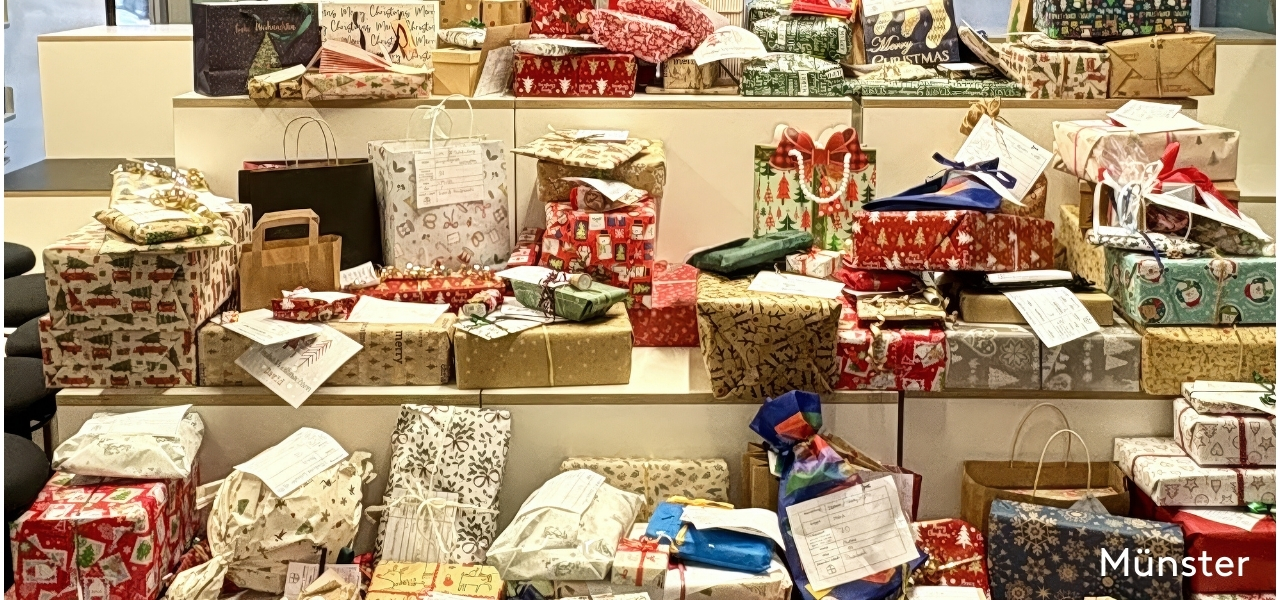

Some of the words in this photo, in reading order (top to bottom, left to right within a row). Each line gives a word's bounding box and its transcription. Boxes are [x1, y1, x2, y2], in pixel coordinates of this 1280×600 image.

[866, 35, 913, 55] Merry
[392, 330, 403, 365] merry
[263, 366, 286, 387] David
